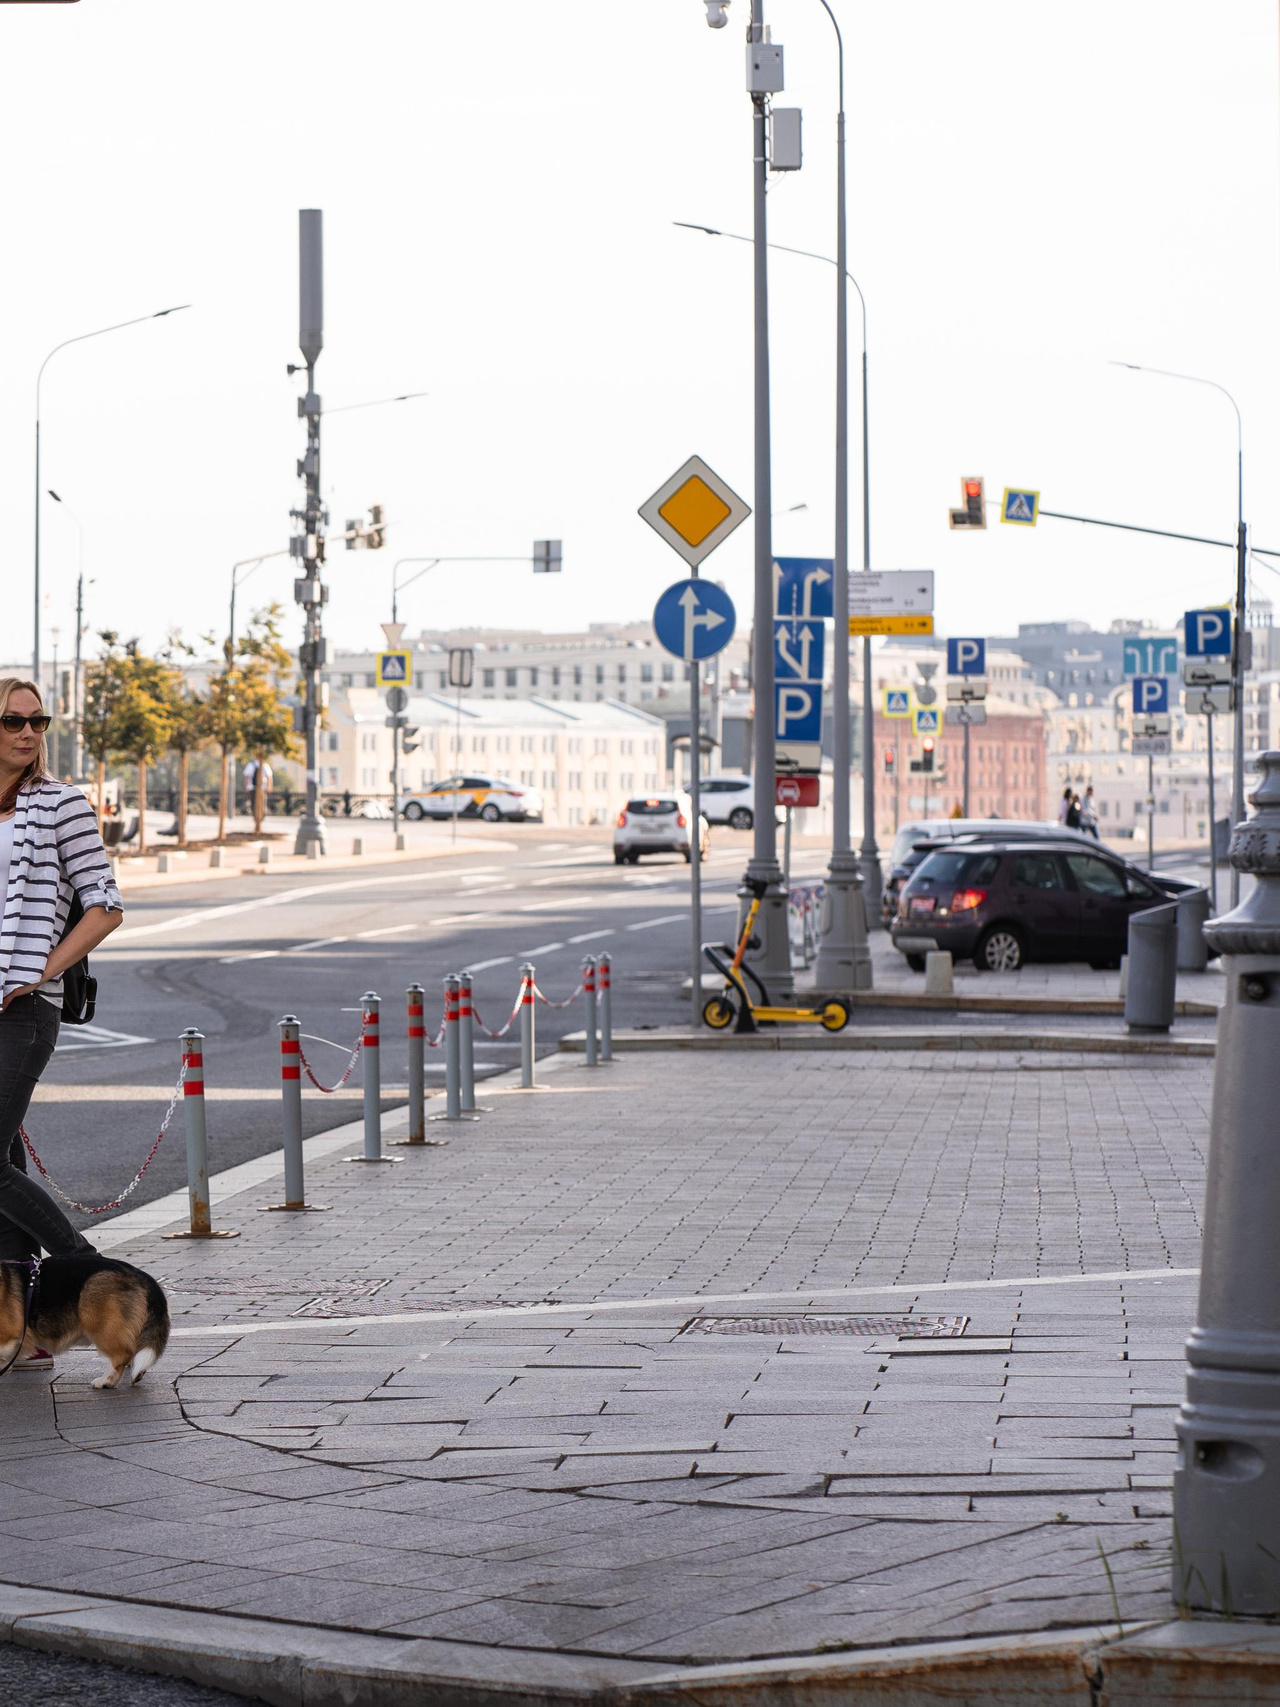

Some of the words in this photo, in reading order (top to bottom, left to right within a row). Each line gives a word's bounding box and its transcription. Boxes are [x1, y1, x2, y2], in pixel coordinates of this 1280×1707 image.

[1196, 614, 1223, 652] P
[957, 640, 980, 672] P
[777, 687, 812, 736] P
[1141, 681, 1162, 711] P
